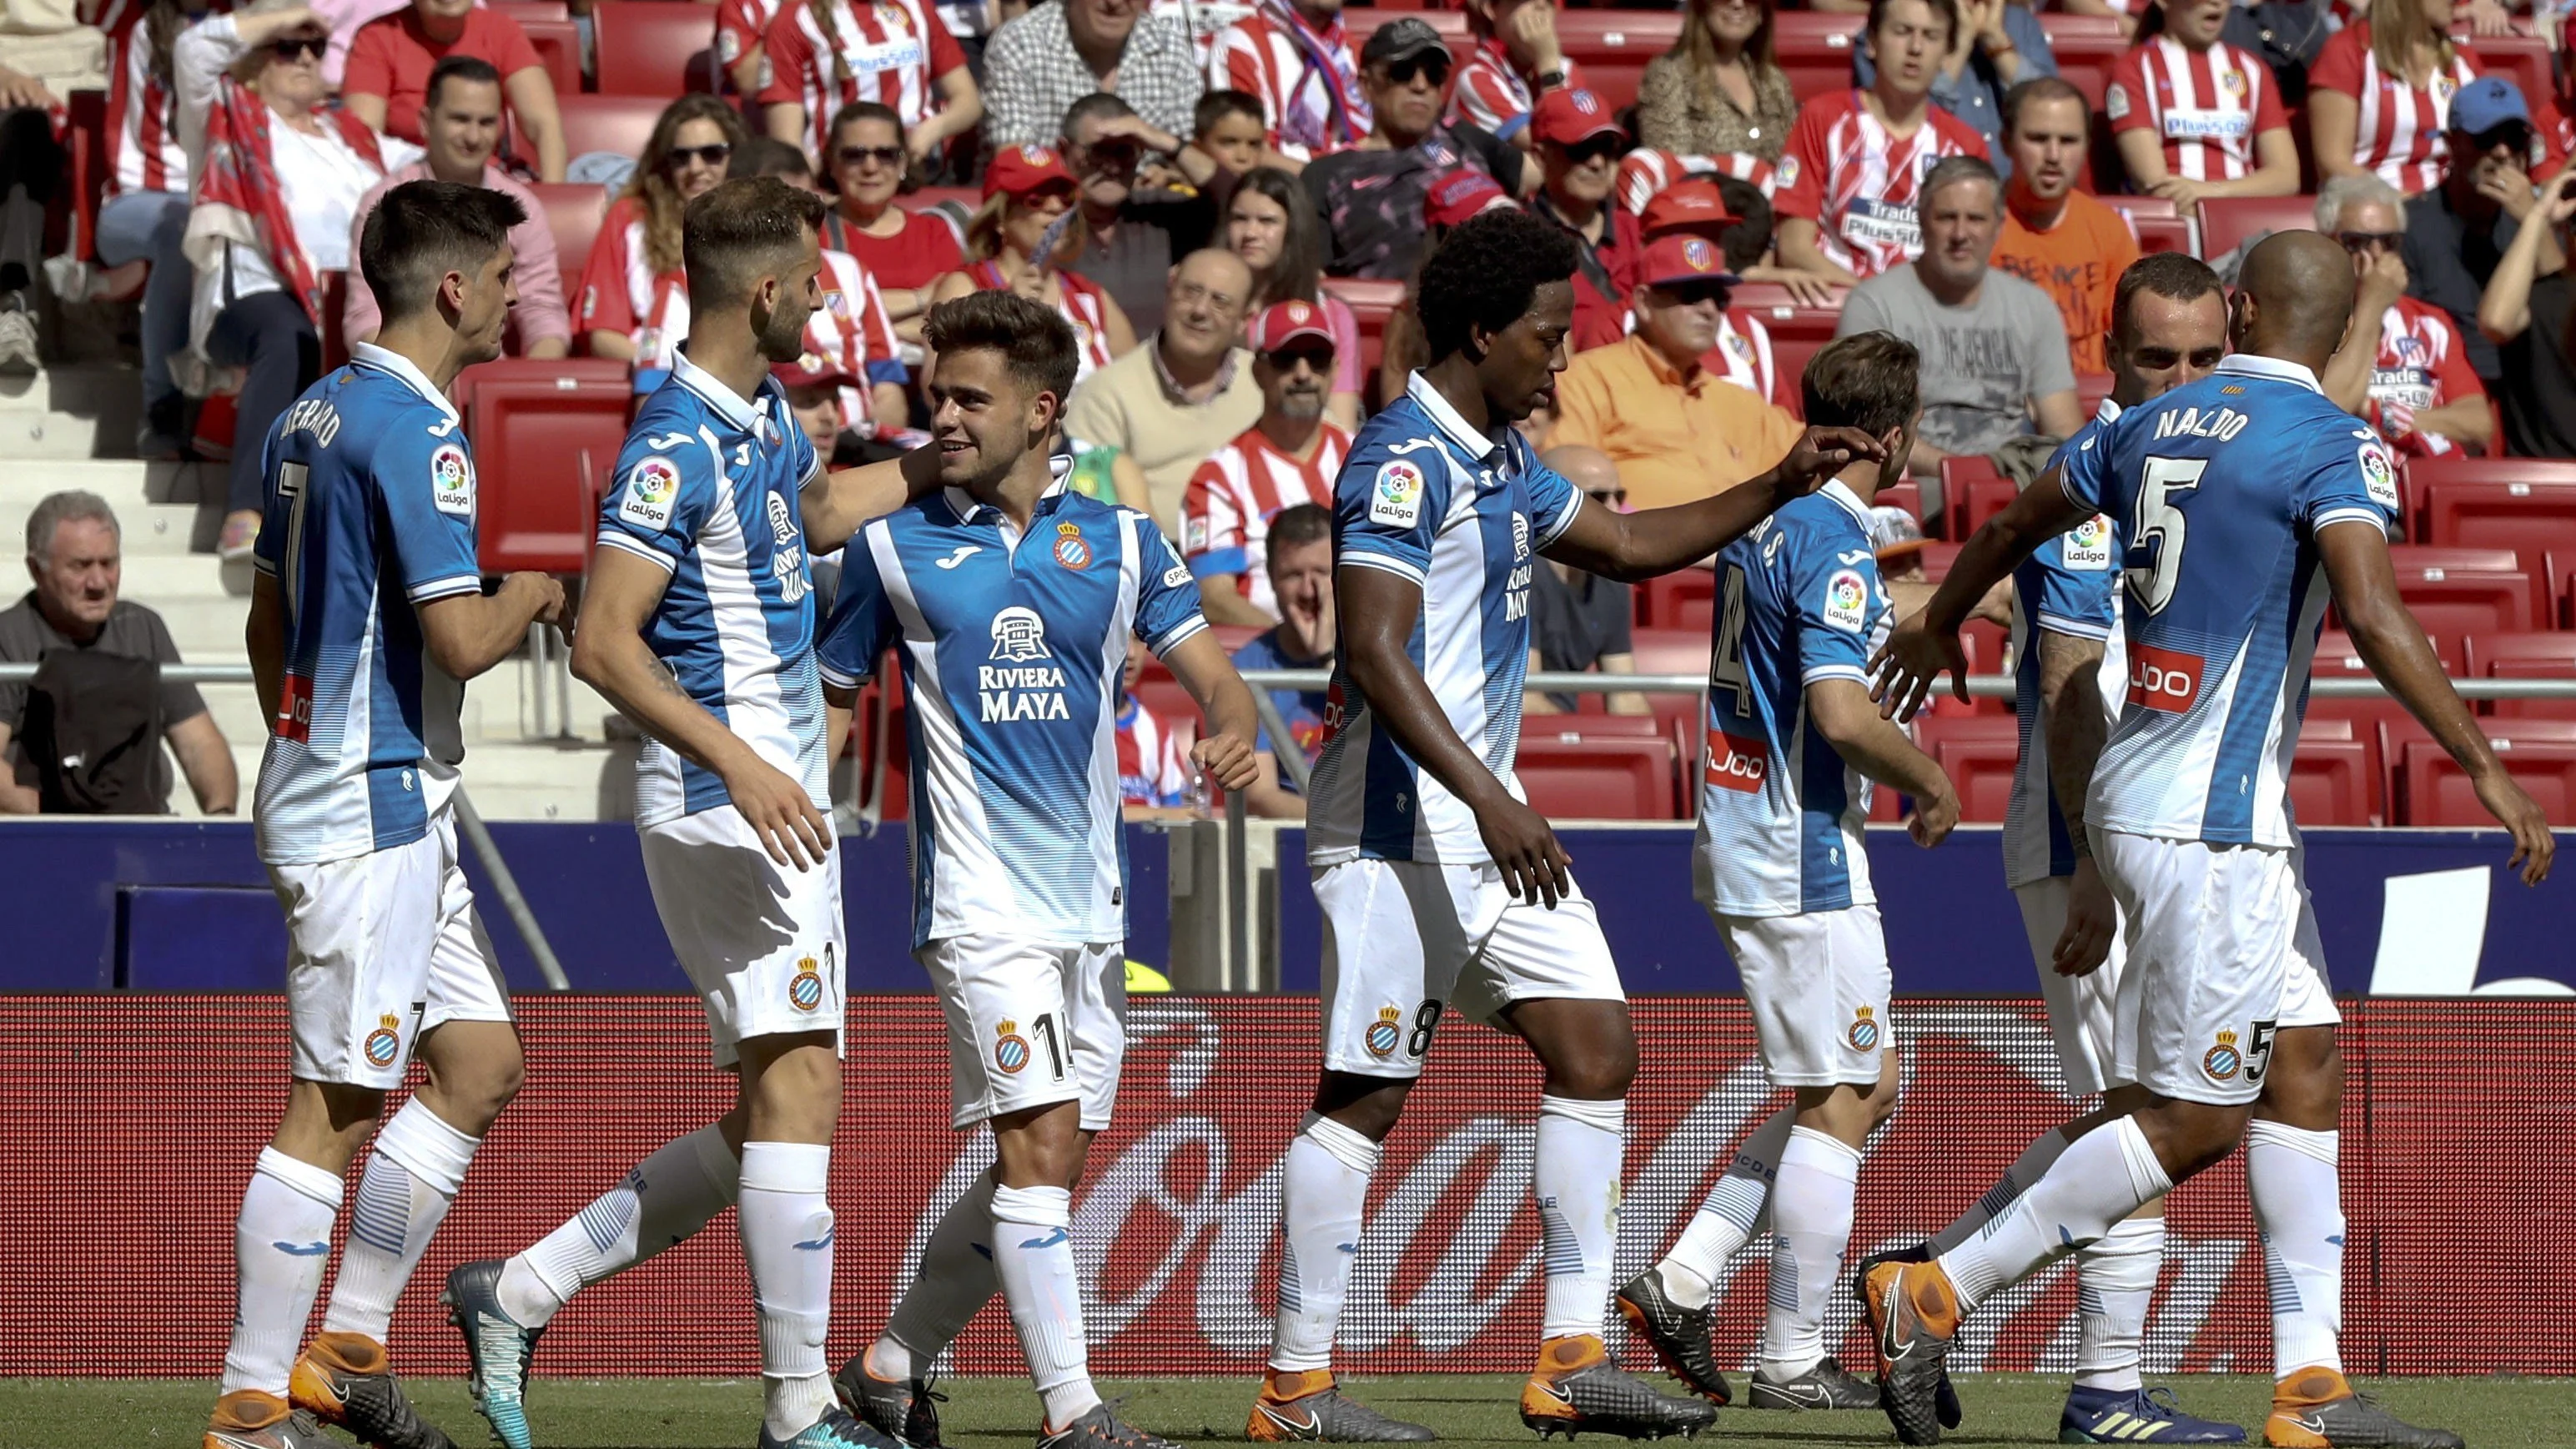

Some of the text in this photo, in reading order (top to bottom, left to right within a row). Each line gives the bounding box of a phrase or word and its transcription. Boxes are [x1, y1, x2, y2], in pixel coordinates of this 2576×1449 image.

[2153, 407, 2249, 443] NALDO
[438, 492, 468, 506] LaLiga
[2369, 484, 2395, 501] LaLiga
[626, 501, 665, 521] LaLiga
[1376, 504, 1414, 520] LaLiga
[277, 460, 309, 626] 7
[2125, 454, 2211, 619] 5
[2067, 549, 2106, 563] LaLiga
[1827, 608, 1860, 626] LaLiga
[1710, 564, 1751, 719] 4
[979, 666, 1067, 690] RIVIERA
[979, 691, 1071, 724] MAYA
[402, 1002, 426, 1070] 7
[1403, 998, 1443, 1062] 8
[2241, 1020, 2278, 1084] 5
